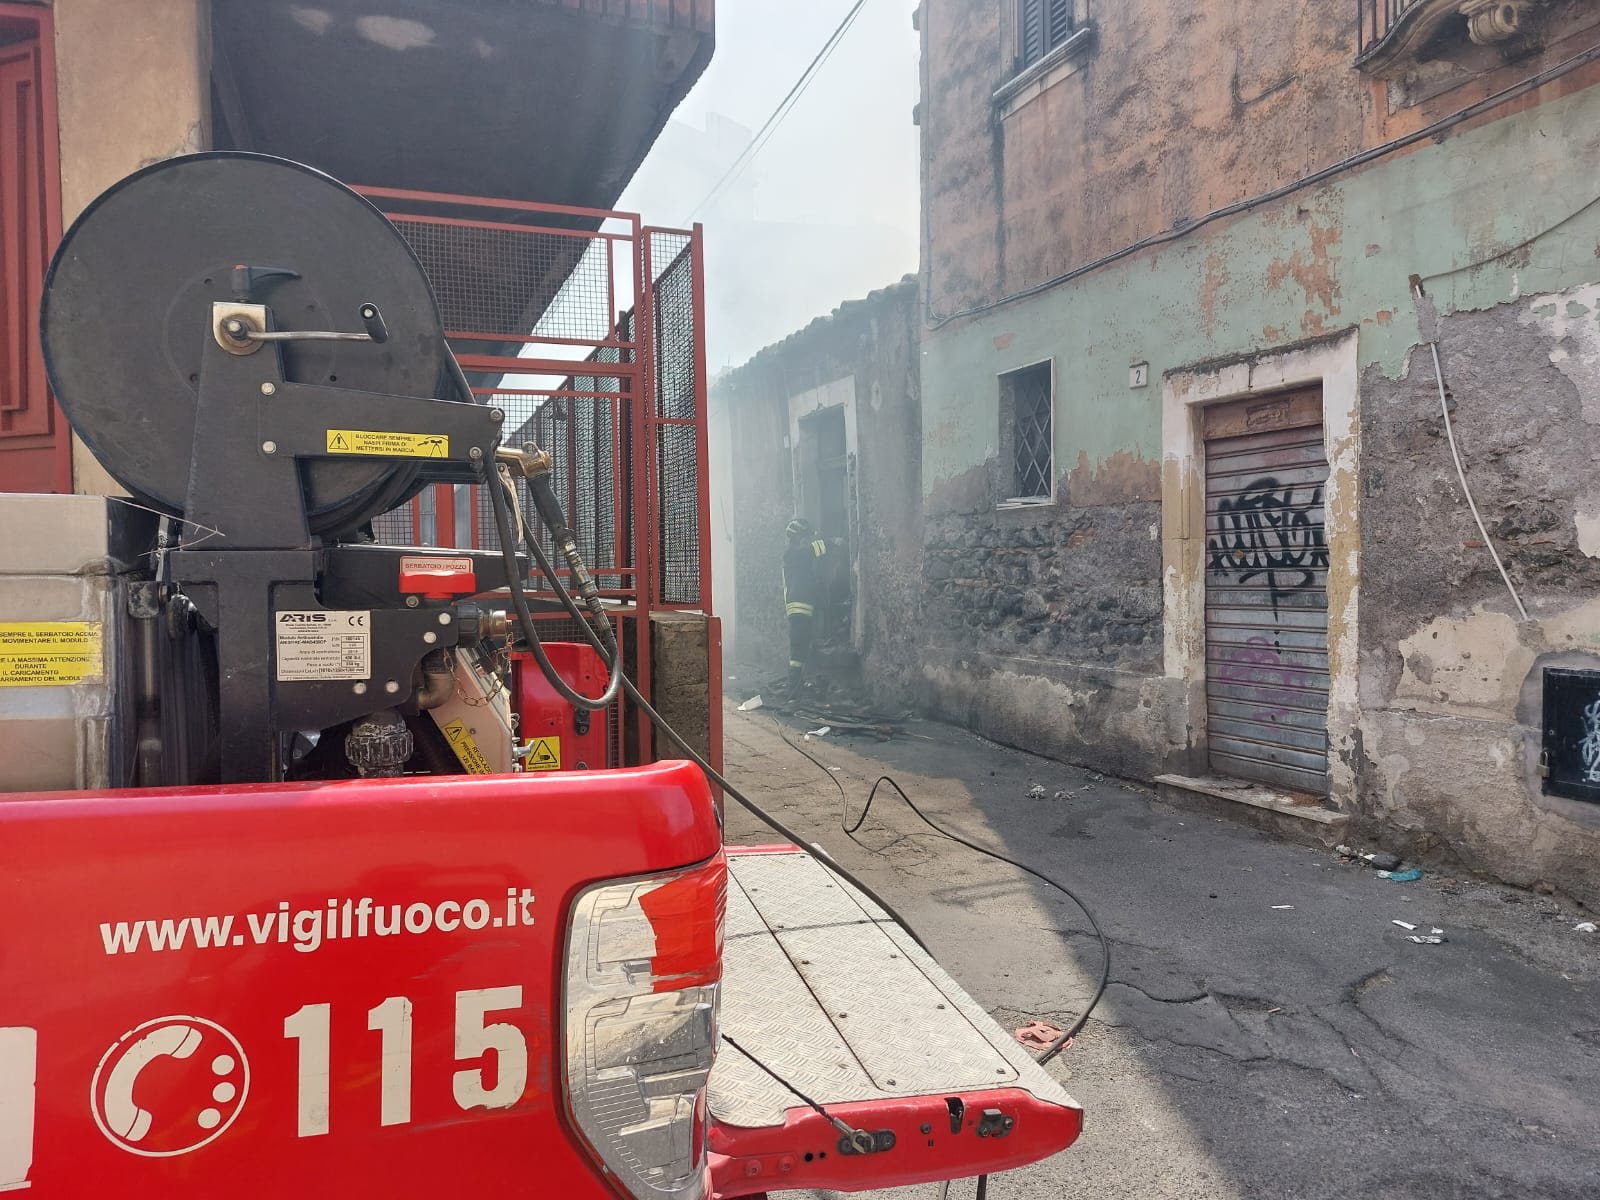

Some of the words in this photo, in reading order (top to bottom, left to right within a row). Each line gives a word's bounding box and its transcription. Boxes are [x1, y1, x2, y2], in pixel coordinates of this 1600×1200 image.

[1135, 369, 1141, 384] 2
[280, 614, 326, 622] ARIS
[100, 887, 536, 955] www.vigilfuoco.it
[283, 985, 529, 1138] 115
